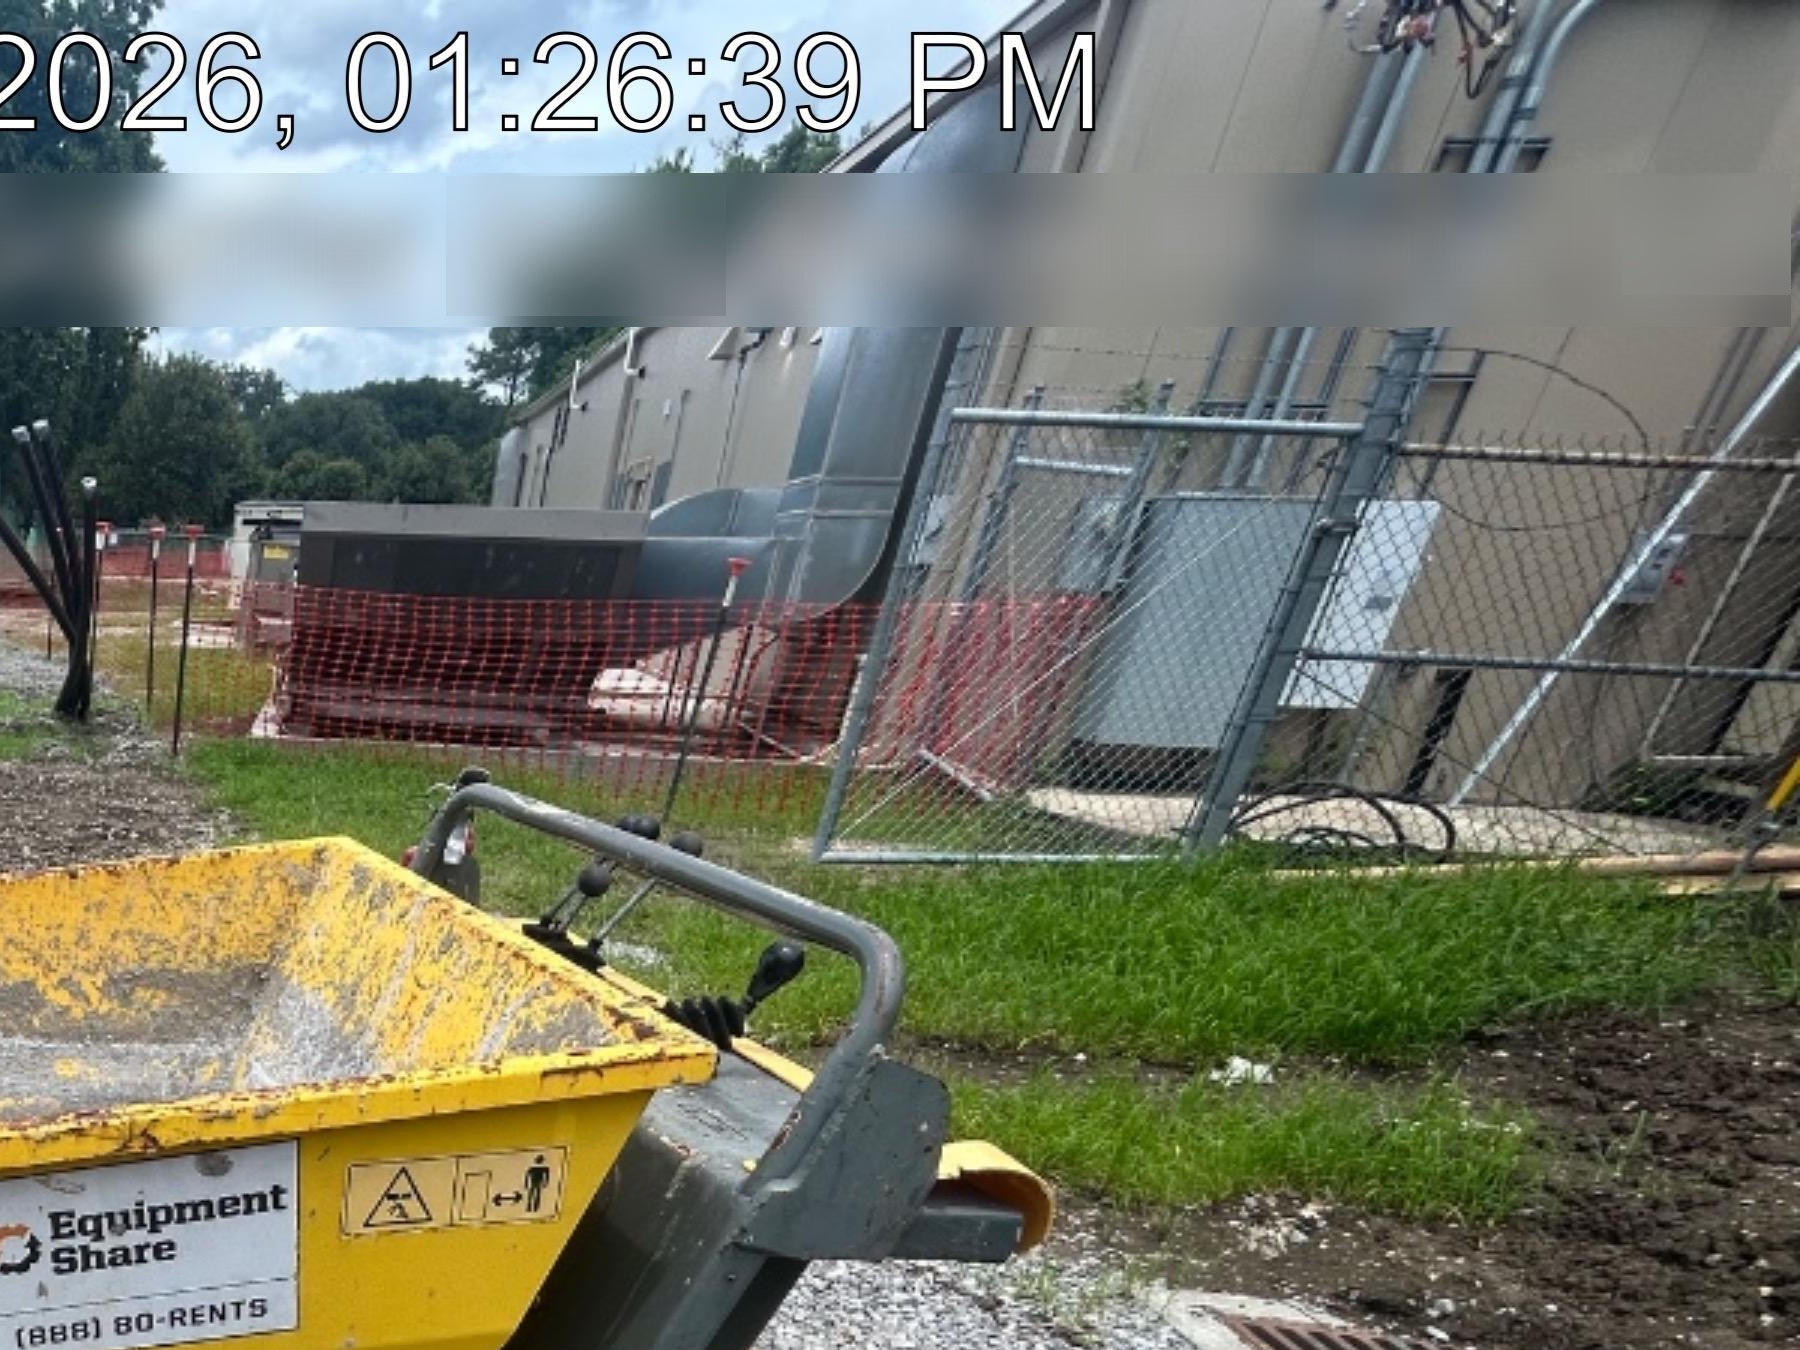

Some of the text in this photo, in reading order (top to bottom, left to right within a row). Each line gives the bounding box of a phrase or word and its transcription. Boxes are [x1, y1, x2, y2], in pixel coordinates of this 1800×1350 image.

[48, 1184, 288, 1241] Equipment
[50, 1239, 178, 1275] Share
[15, 1298, 268, 1349] (888) 80-RENTS
